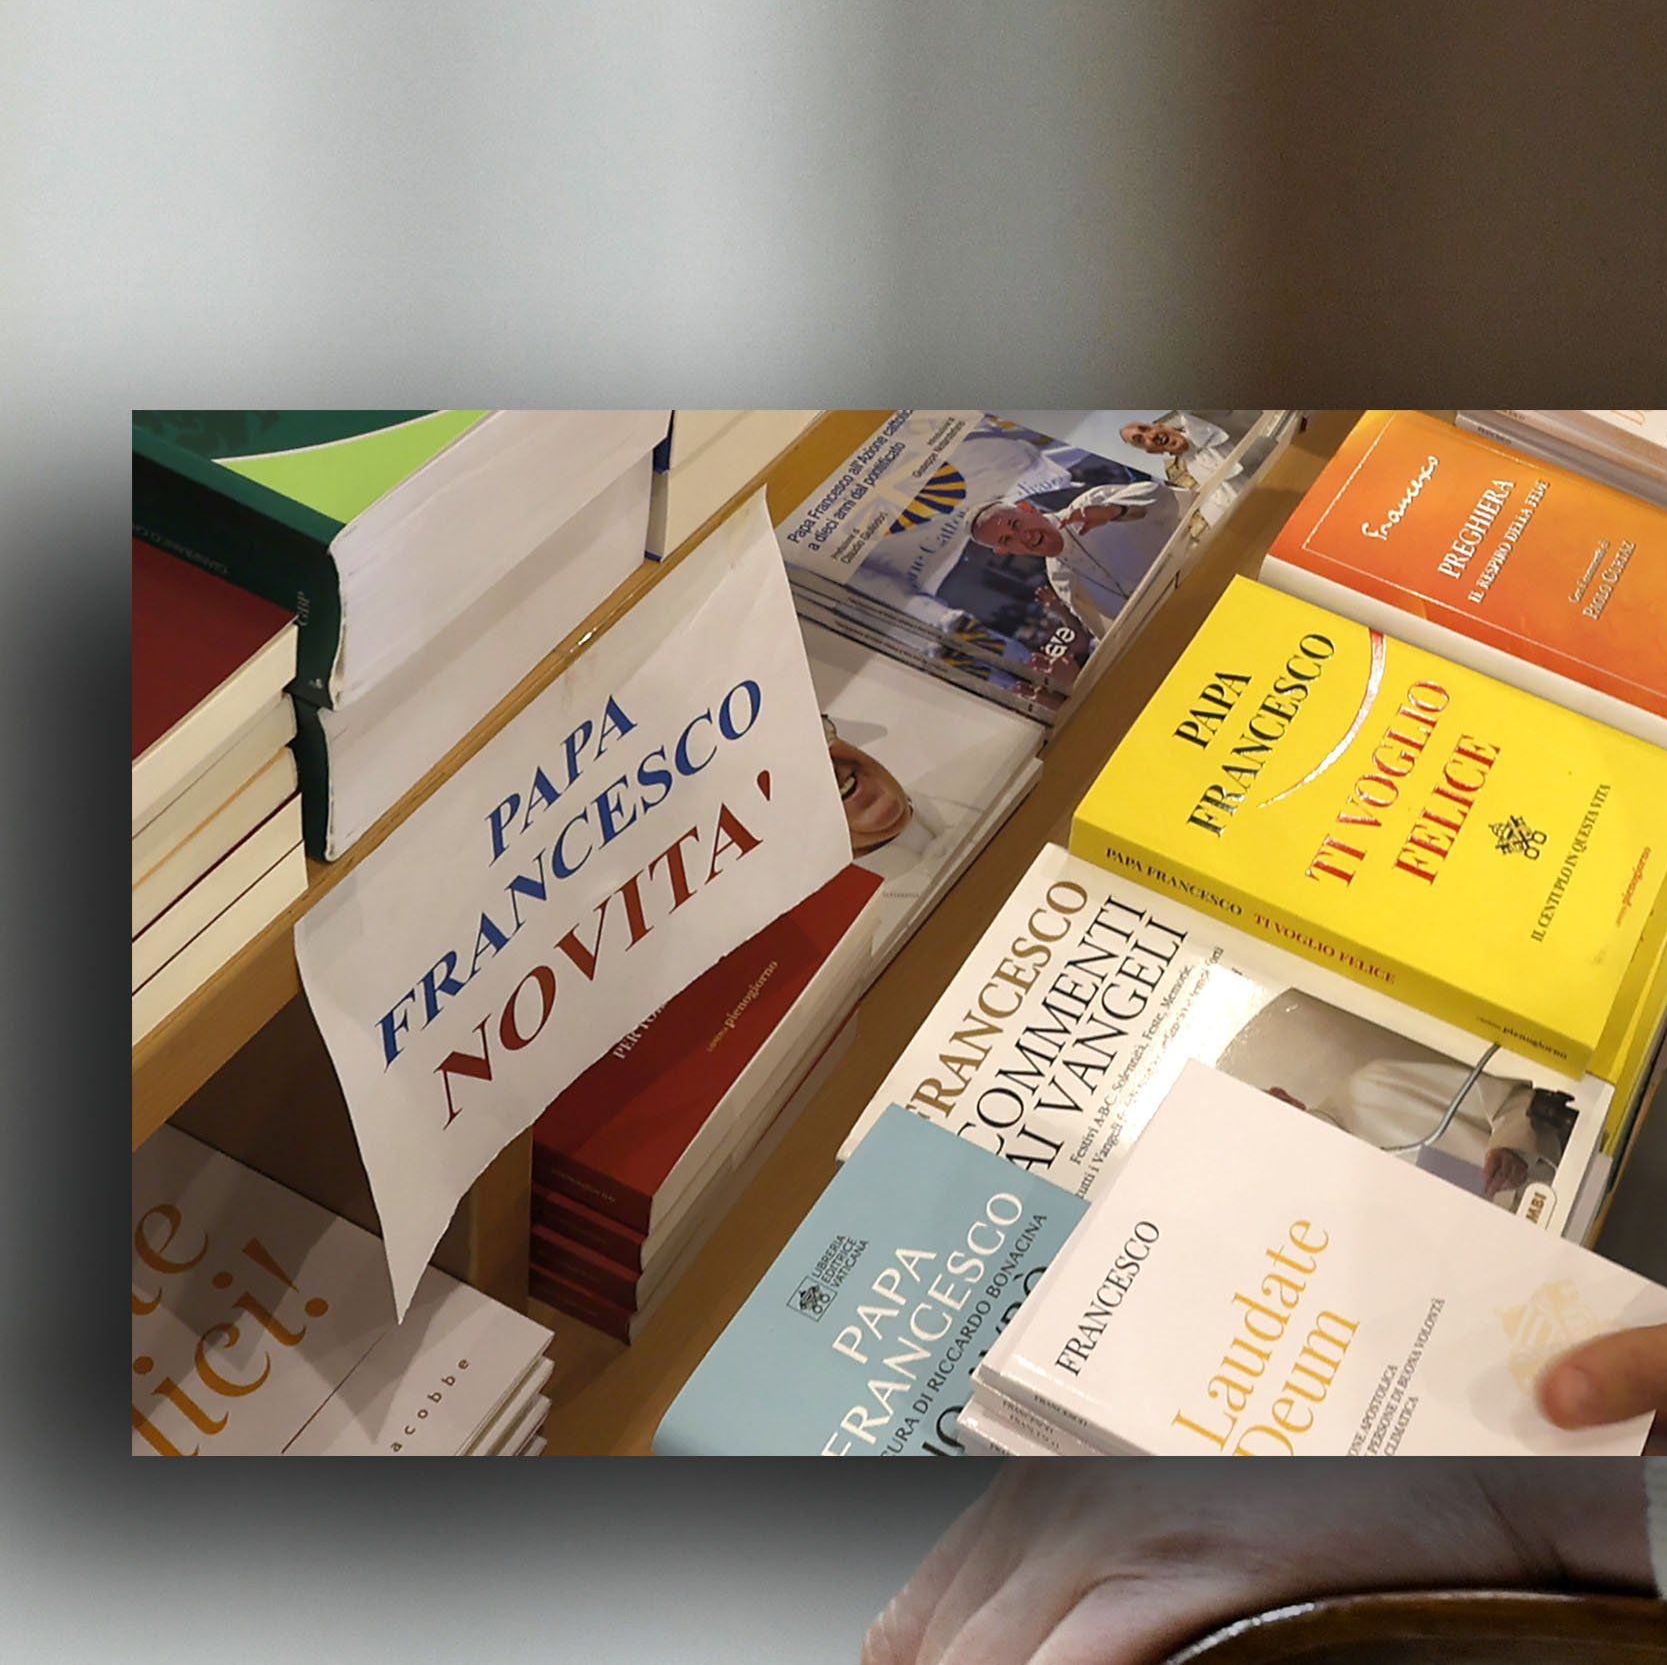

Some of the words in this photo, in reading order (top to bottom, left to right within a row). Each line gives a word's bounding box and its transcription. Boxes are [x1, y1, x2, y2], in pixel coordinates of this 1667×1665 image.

[787, 518, 816, 544] Papa
[807, 474, 854, 520] Francesco
[808, 541, 820, 552] a
[815, 518, 840, 543] dieci
[834, 497, 857, 520] anni
[863, 441, 907, 487] pontificato
[1503, 506, 1534, 544] DELLA
[1525, 479, 1551, 509] FEDE
[1437, 479, 1516, 579] PREGHIERA
[1467, 590, 1485, 605] IL
[1475, 541, 1514, 591] RESPIRO
[1173, 669, 1253, 749] PAPA
[1187, 633, 1337, 839] FRANCESCO
[484, 694, 638, 867] PAPA
[1336, 680, 1452, 830] VOGLIO
[1392, 732, 1502, 886] FELICE
[1589, 783, 1612, 809] VITA
[1306, 834, 1368, 888] TI
[1564, 850, 1579, 868] IN
[1572, 810, 1600, 853] QUESTA
[374, 680, 763, 1073] FRANCESCO
[1538, 866, 1574, 929] CENTUPLO
[1105, 846, 1144, 875] PAPA
[1143, 862, 1243, 917] FRANCESCO
[1253, 911, 1275, 930] TI
[1269, 918, 1336, 960] VOGLIO
[1338, 951, 1397, 985] FELICE
[1530, 928, 1547, 943] IL
[432, 769, 772, 1131] NOVITA'
[724, 960, 780, 1030] pienogiorno
[1034, 916, 1190, 1115] VANGELI
[1069, 1125, 1099, 1166] Festivi
[1091, 1123, 1124, 1165] Vangeli
[811, 1235, 847, 1279] LIBRERIA
[821, 1237, 858, 1284] EDITRICE
[830, 1240, 869, 1288] VATICANA
[821, 1191, 1024, 1456] FRANCESCO
[832, 1246, 937, 1365] PAPA
[912, 1390, 934, 1416] DI
[927, 1299, 993, 1393] RICCARDO
[986, 1213, 1048, 1297] BONACINA
[1055, 1219, 1160, 1377] FRANCESCO
[1413, 1297, 1446, 1349] VOLONTÀ
[1171, 1218, 1330, 1450] Laudate
[1234, 1309, 1361, 1456] Deum
[1360, 1363, 1399, 1435] APOSTOLICA
[1390, 1387, 1405, 1404] DI
[1397, 1349, 1423, 1390] BUONA
[1367, 1402, 1398, 1455] PERSONE
[1383, 1395, 1420, 1456] CLIMATICA
